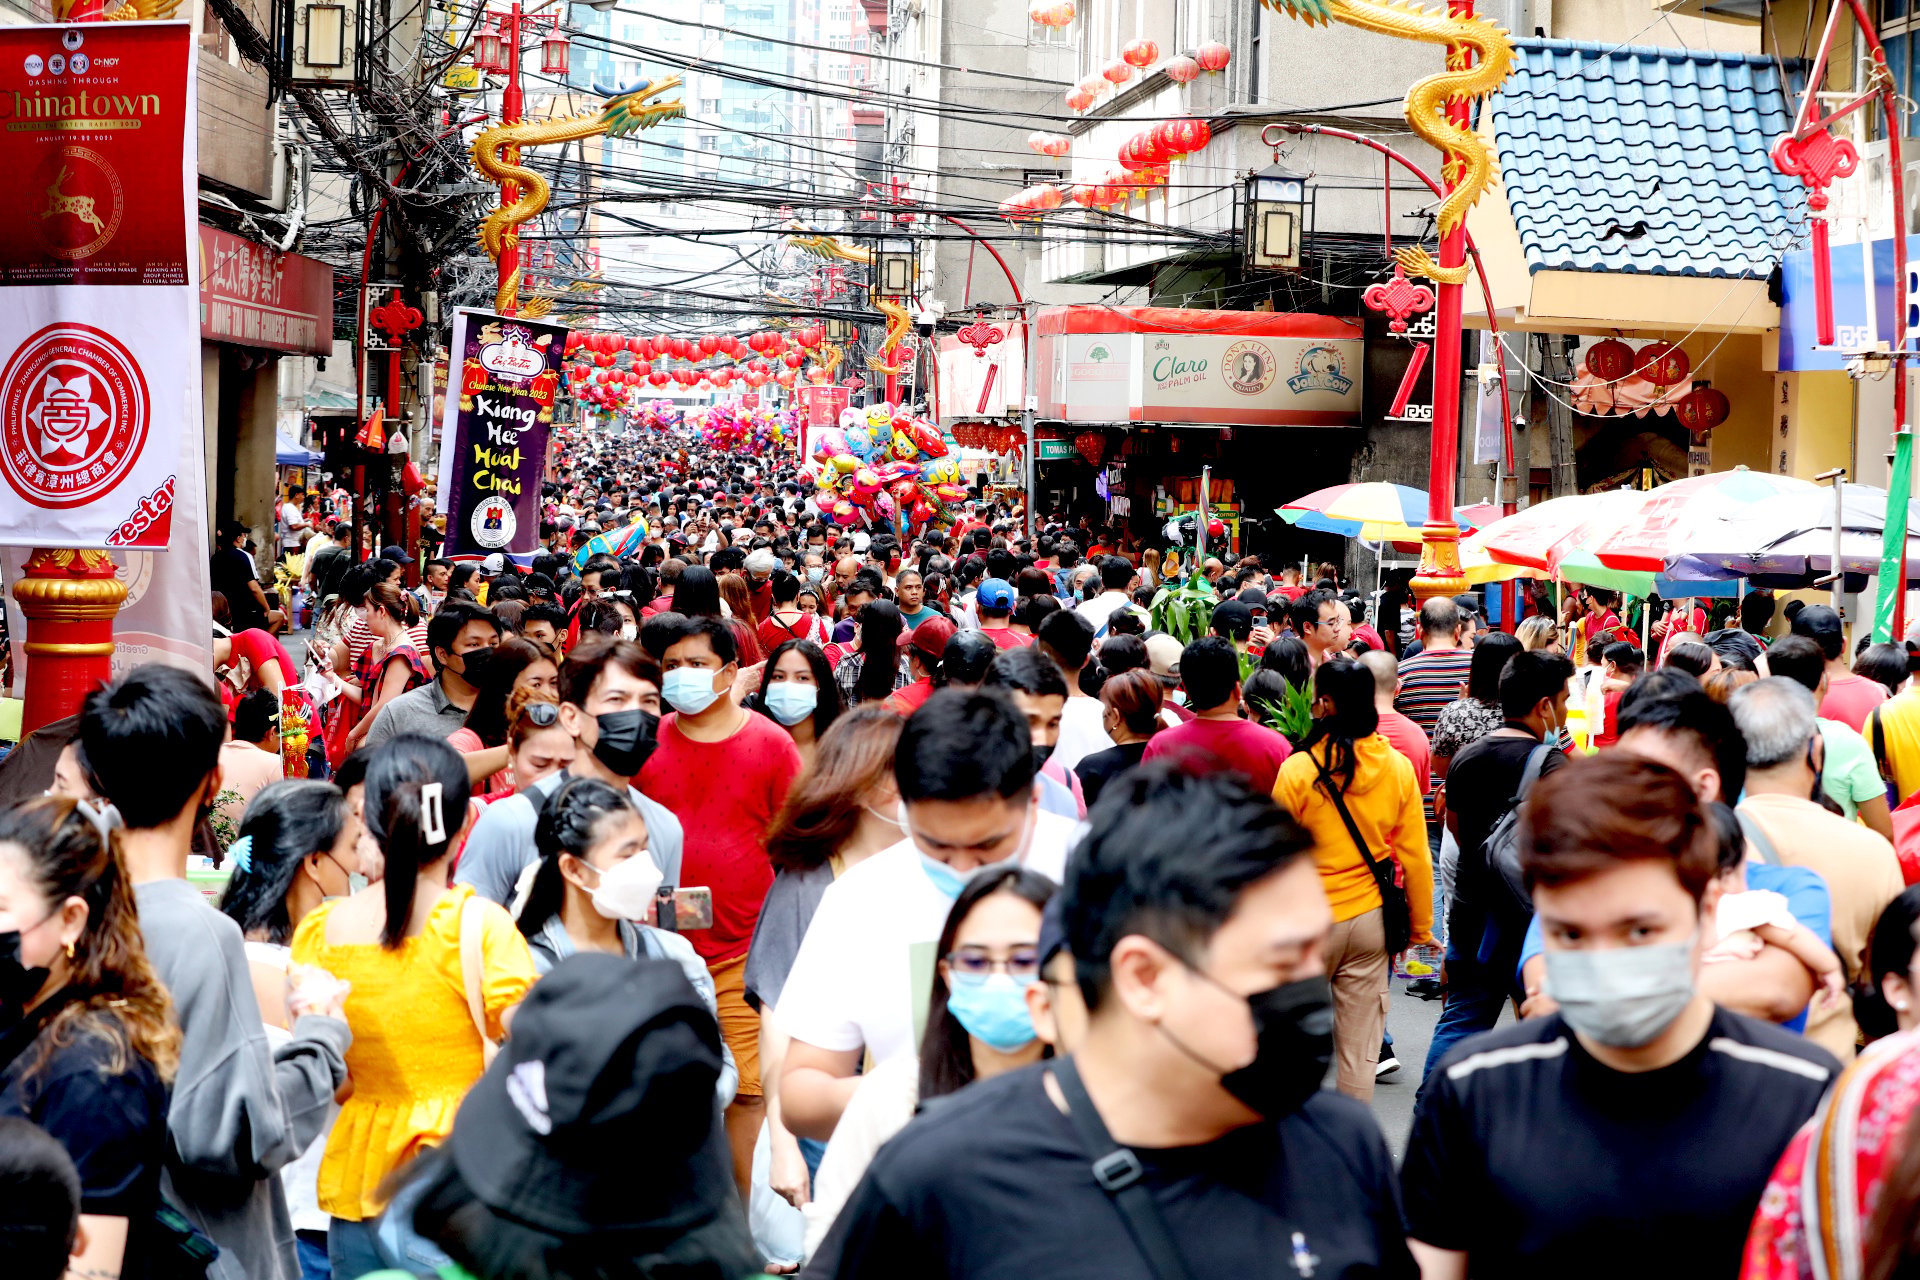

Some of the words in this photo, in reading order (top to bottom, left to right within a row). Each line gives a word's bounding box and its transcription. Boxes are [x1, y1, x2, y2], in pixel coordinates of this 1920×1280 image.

[28, 77, 68, 87] DASHING
[72, 76, 119, 85] THROUGH
[88, 120, 116, 128] RABBIT
[36, 135, 66, 143] JANUARY
[211, 301, 231, 336] HONG
[232, 305, 243, 337] TAI
[244, 308, 260, 340] YANG
[260, 311, 286, 344] CHINESE
[48, 345, 77, 356] GENERAL
[77, 348, 110, 371] CHAMBER
[1251, 343, 1273, 373] ELENA
[20, 352, 50, 386] ZHANGZHOU
[108, 367, 118, 378] OF
[1152, 356, 1208, 382] Claro
[469, 380, 496, 392] Chinese
[497, 383, 512, 393] New
[512, 387, 529, 397] Year
[529, 389, 548, 400] 2023
[1168, 377, 1191, 389] PALM
[1193, 373, 1207, 382] OIL
[1235, 384, 1261, 392] QUALITY
[114, 377, 129, 420] COMMERCE
[12, 389, 22, 435] PHILIPPINES
[476, 394, 537, 433] Kiang
[118, 420, 129, 435] INC.
[487, 421, 519, 446] Hee
[473, 443, 527, 471] Huat
[1045, 445, 1068, 454] TOMAS
[15, 448, 118, 489] 菲律賓漳州總商會
[472, 469, 522, 496] Chai
[473, 497, 493, 520] LUNGSOD
[478, 538, 506, 548] PILIPINAS
